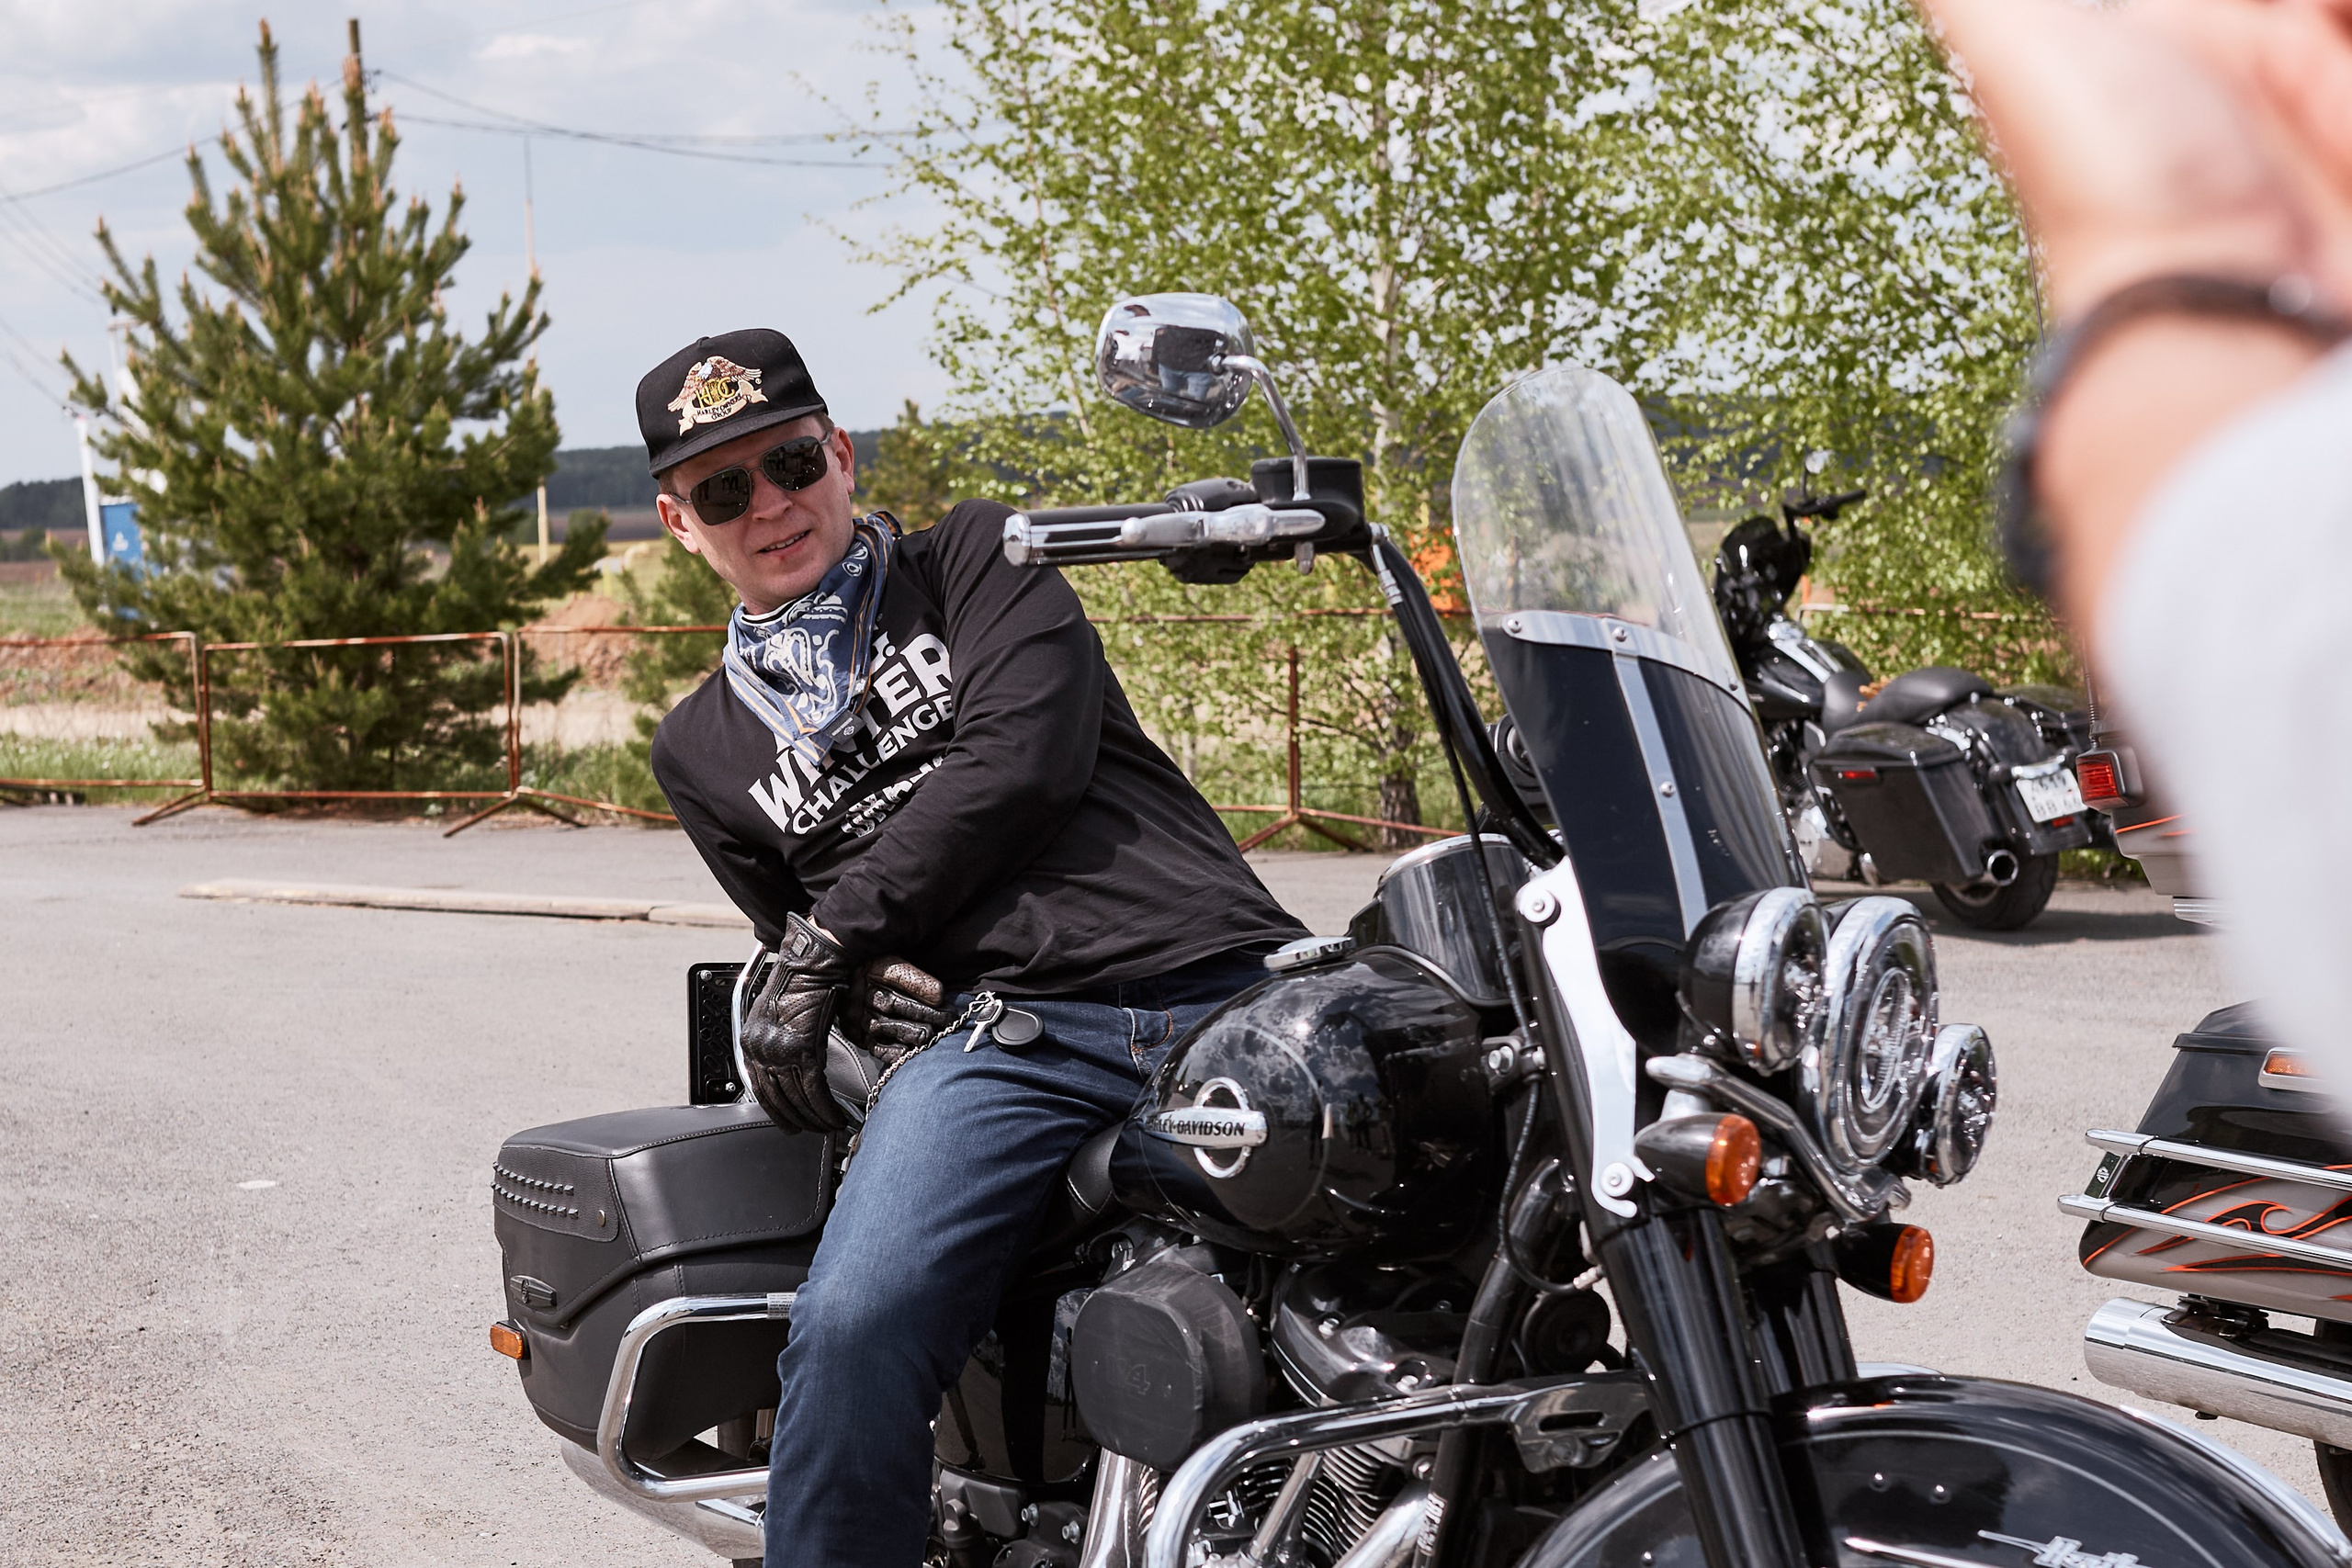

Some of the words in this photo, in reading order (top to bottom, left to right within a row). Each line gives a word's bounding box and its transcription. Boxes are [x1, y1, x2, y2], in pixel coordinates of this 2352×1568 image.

[696, 407, 719, 416] HARLEY
[711, 408, 732, 420] GROUP
[792, 695, 955, 835] CHALLENGE
